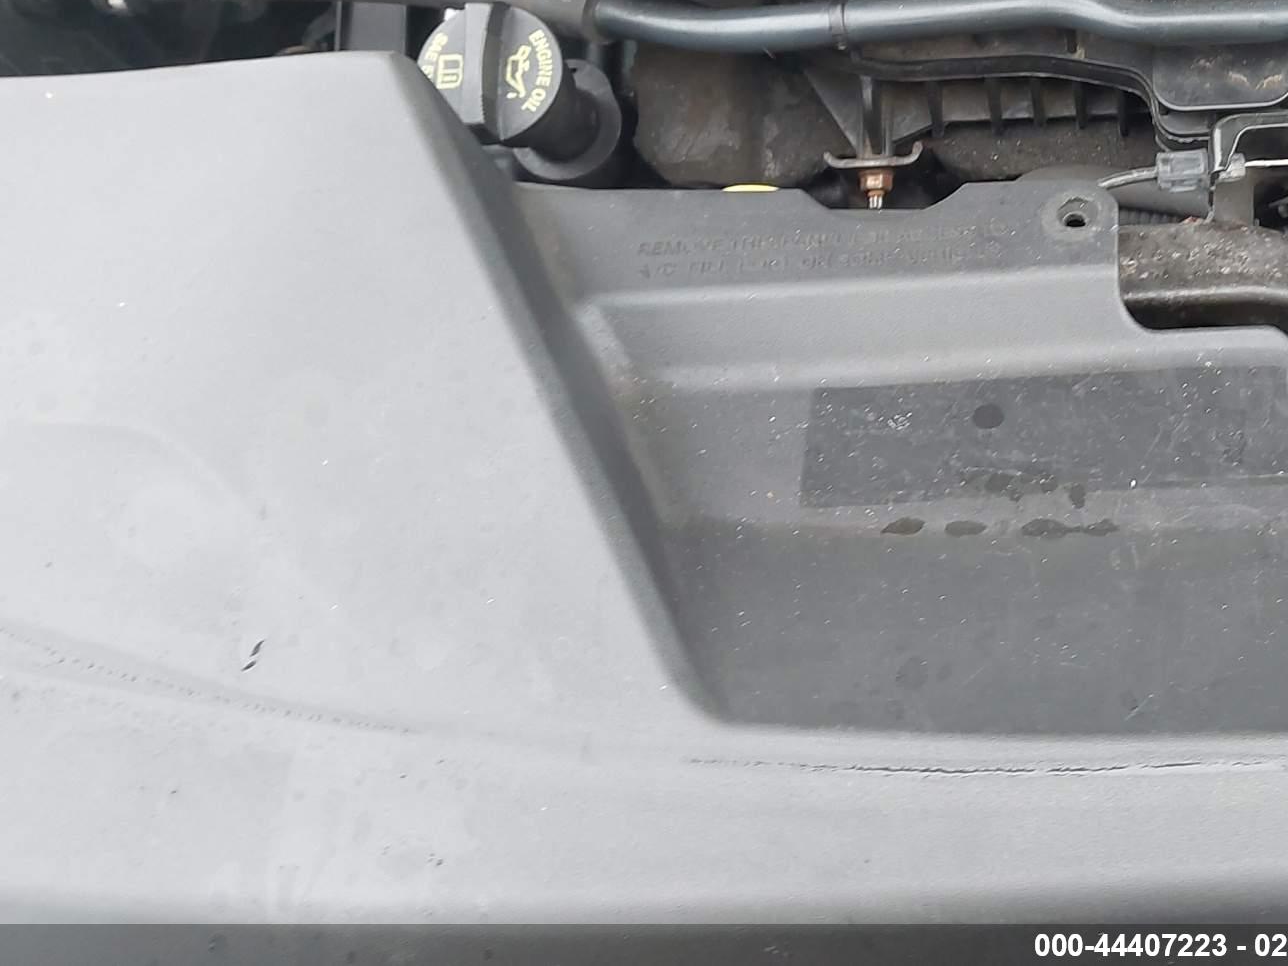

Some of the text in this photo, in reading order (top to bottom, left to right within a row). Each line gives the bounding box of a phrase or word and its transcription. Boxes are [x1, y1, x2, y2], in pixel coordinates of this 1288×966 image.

[424, 32, 448, 62] SAE
[521, 29, 553, 113] ENGINE OIL
